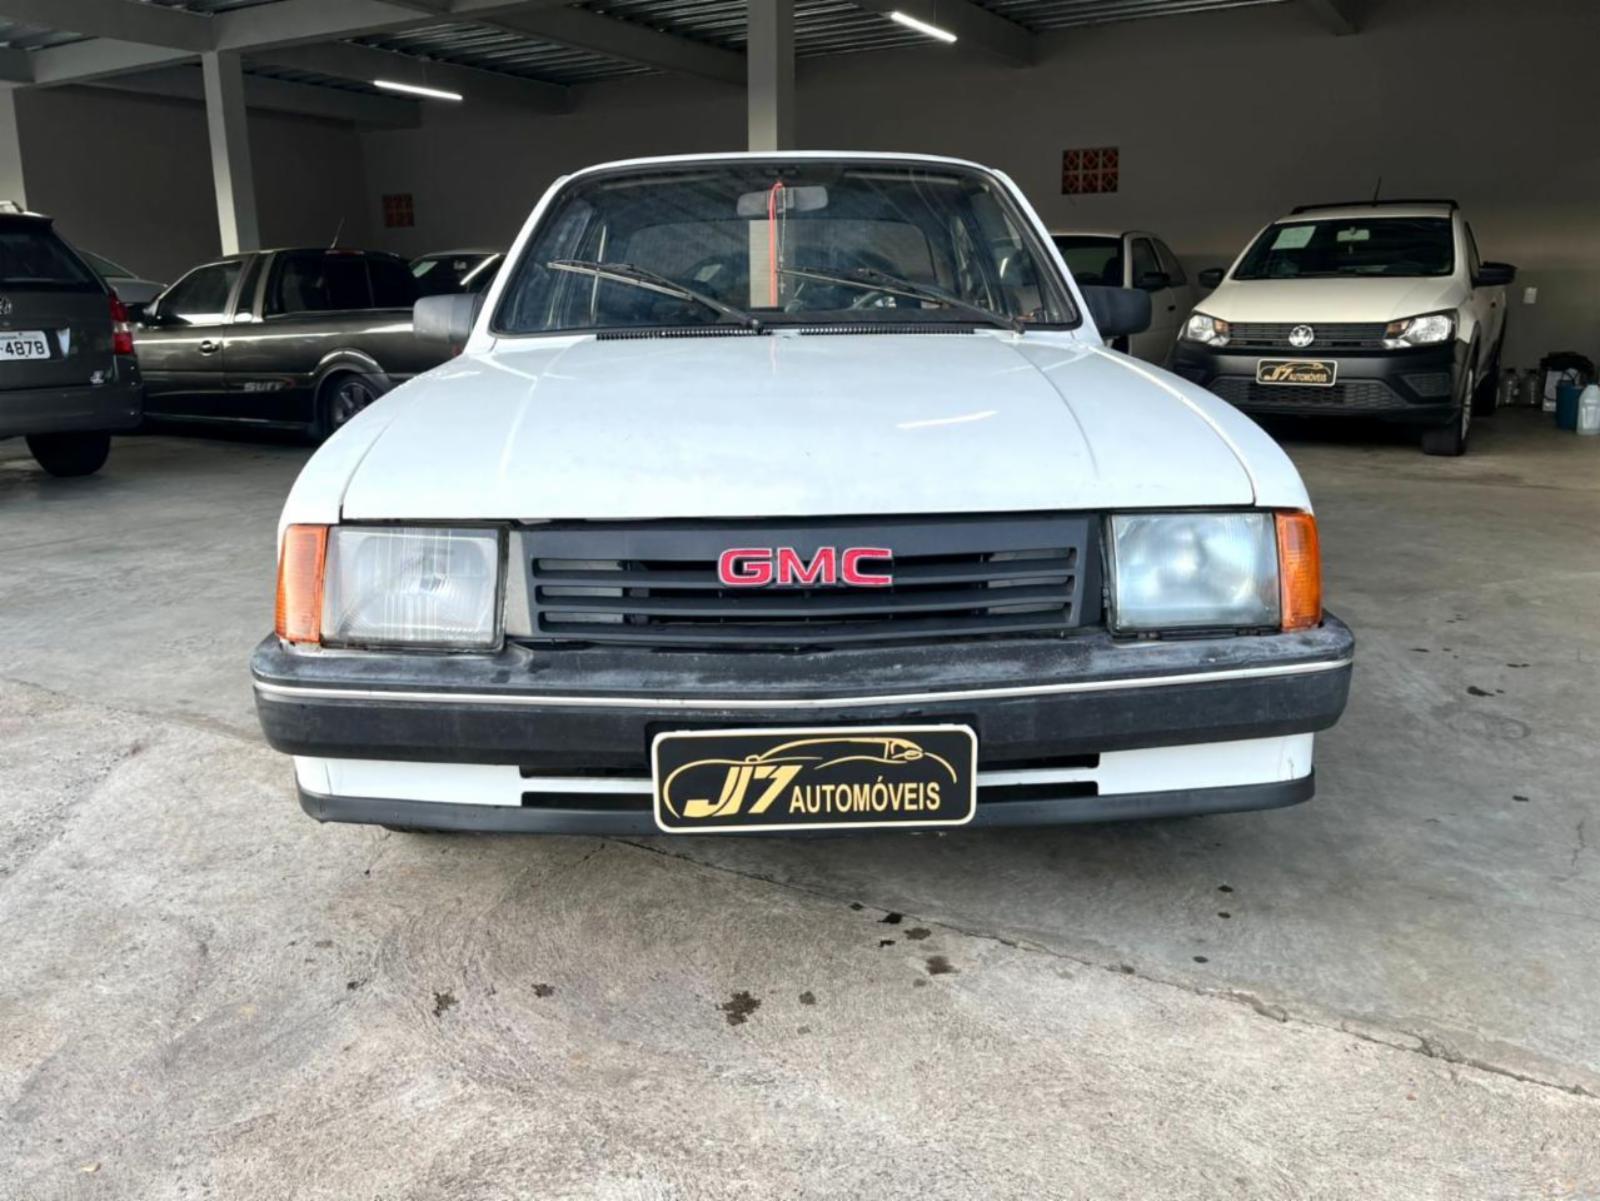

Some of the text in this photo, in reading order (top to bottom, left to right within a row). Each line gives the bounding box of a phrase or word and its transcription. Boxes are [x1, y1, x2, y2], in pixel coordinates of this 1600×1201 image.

[718, 547, 893, 586] GMC
[683, 765, 941, 818] J7 AUTOMÓVEIS
